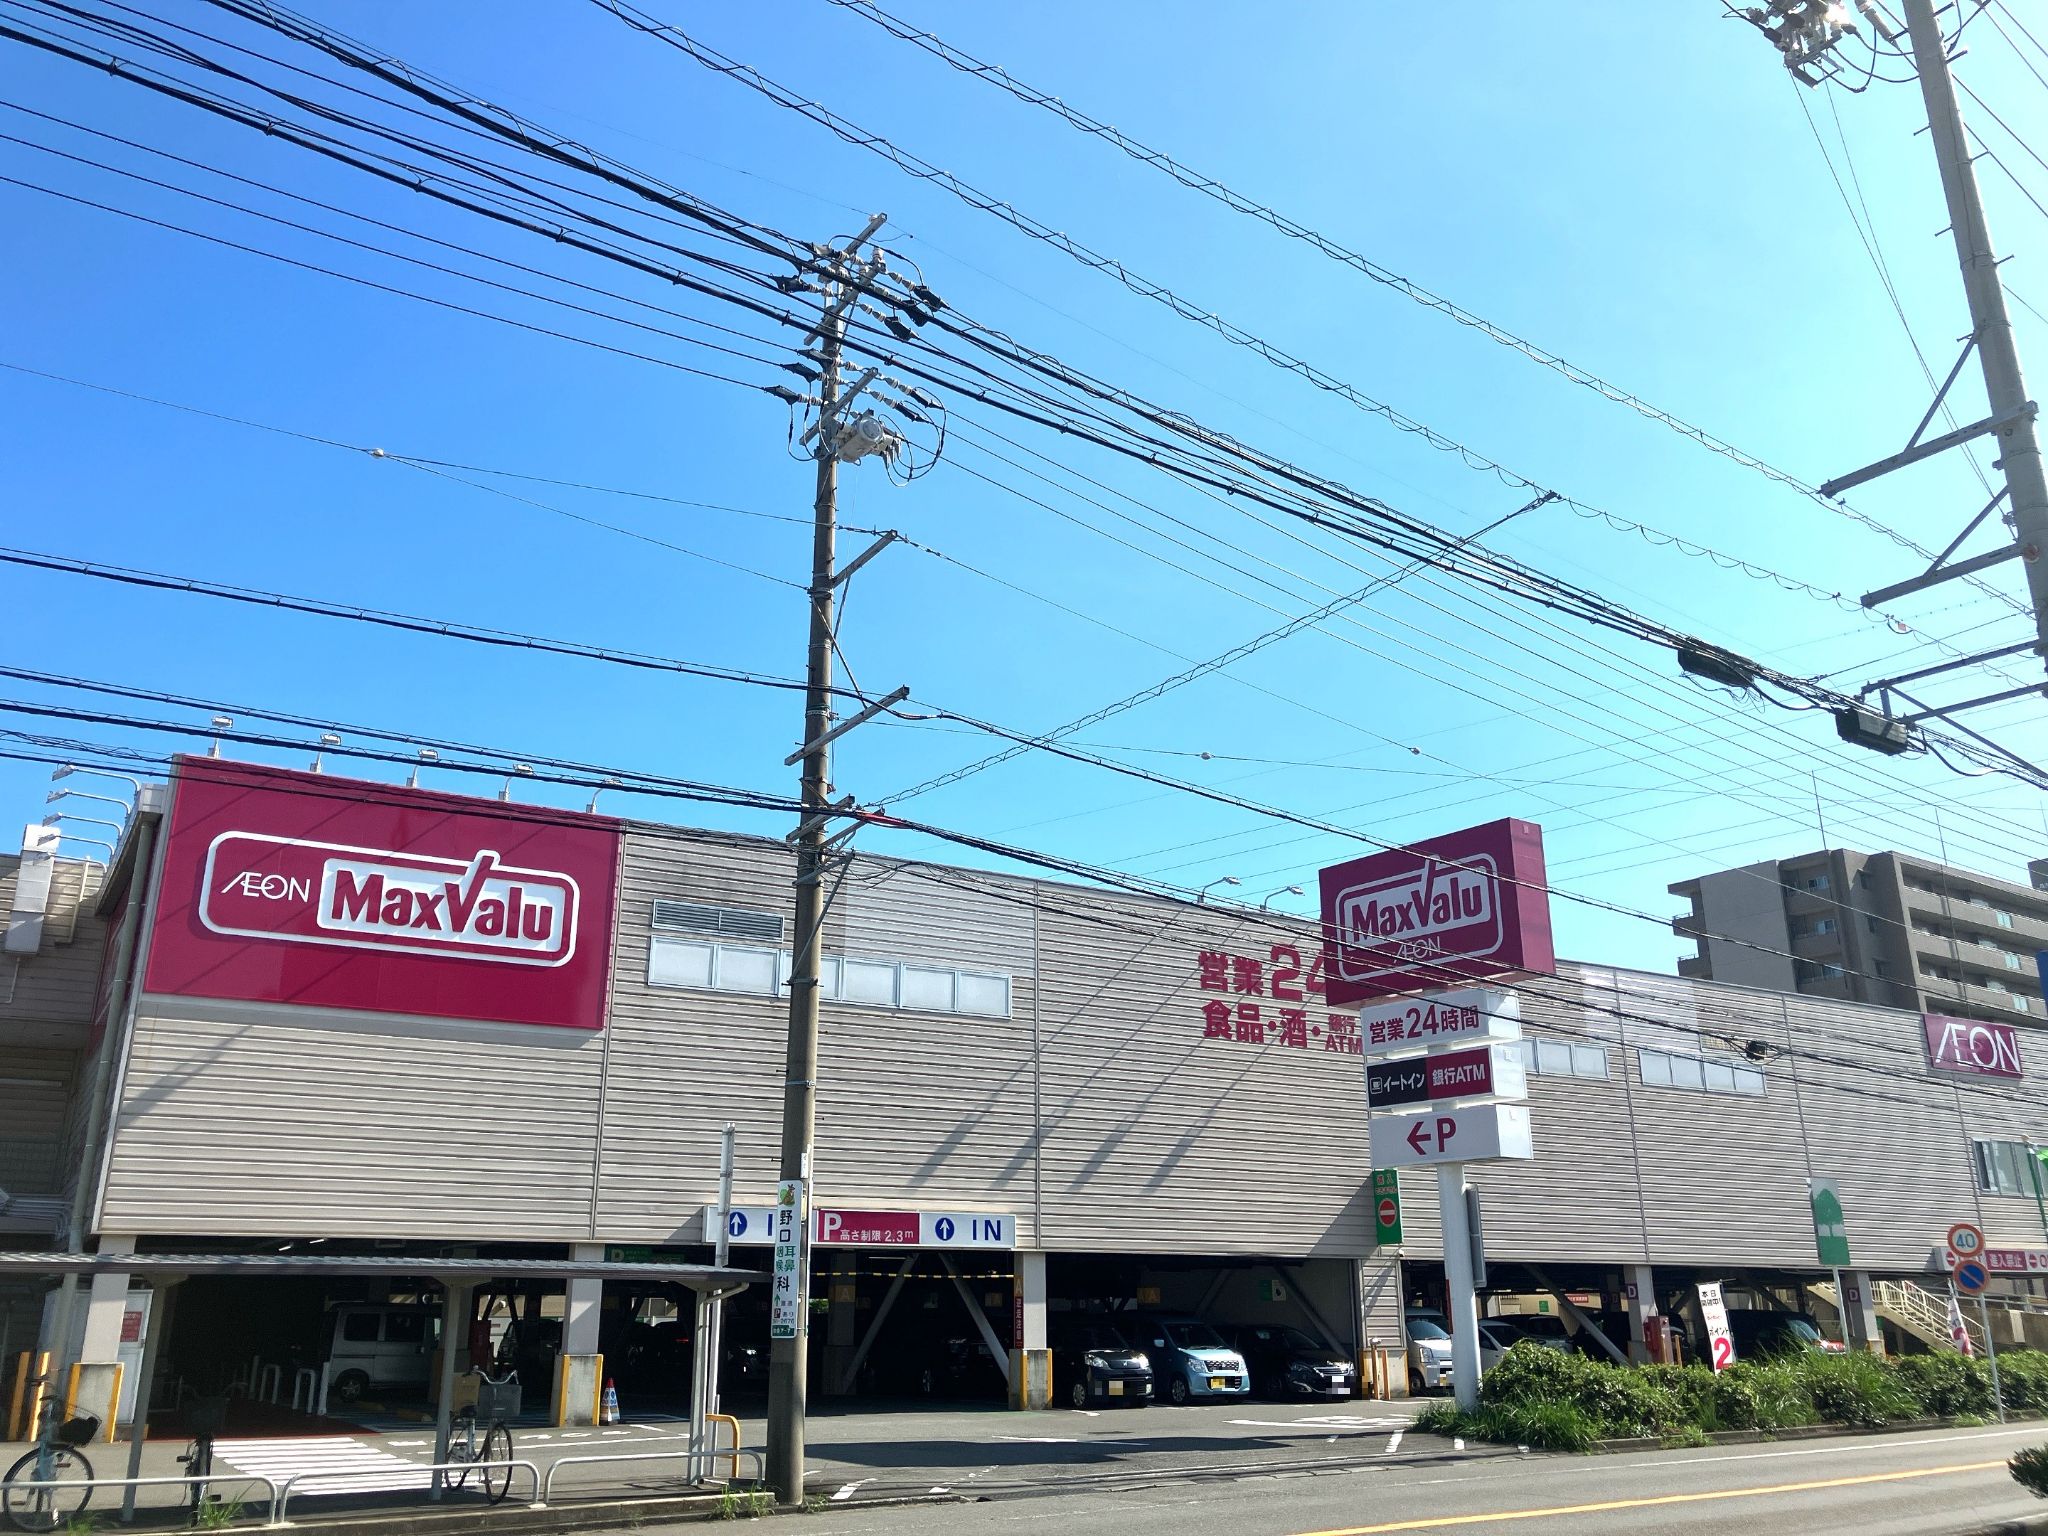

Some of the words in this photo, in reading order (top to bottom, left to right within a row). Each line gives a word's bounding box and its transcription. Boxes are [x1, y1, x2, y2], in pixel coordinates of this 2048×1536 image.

[331, 856, 555, 942] MaxValu
[1351, 858, 1484, 943] MaxValu
[1369, 1005, 1480, 1045] 営業24時間
[1325, 1034, 1363, 1055] ATM
[1383, 1072, 1426, 1093] イートイン
[1432, 1063, 1486, 1087] 銀行ATM
[1436, 1116, 1457, 1153] P
[779, 1210, 793, 1242] 野口
[823, 1212, 842, 1241] P
[839, 1228, 881, 1242] 高さ制限
[884, 1229, 914, 1243] 2.3m
[972, 1219, 1002, 1242] IN
[1955, 1233, 1976, 1249] 40
[777, 1276, 789, 1292] 科
[1627, 1285, 1637, 1298] D
[1701, 1289, 1717, 1298] 本日
[1849, 1289, 1859, 1301] D
[1713, 1337, 1732, 1370] 2
